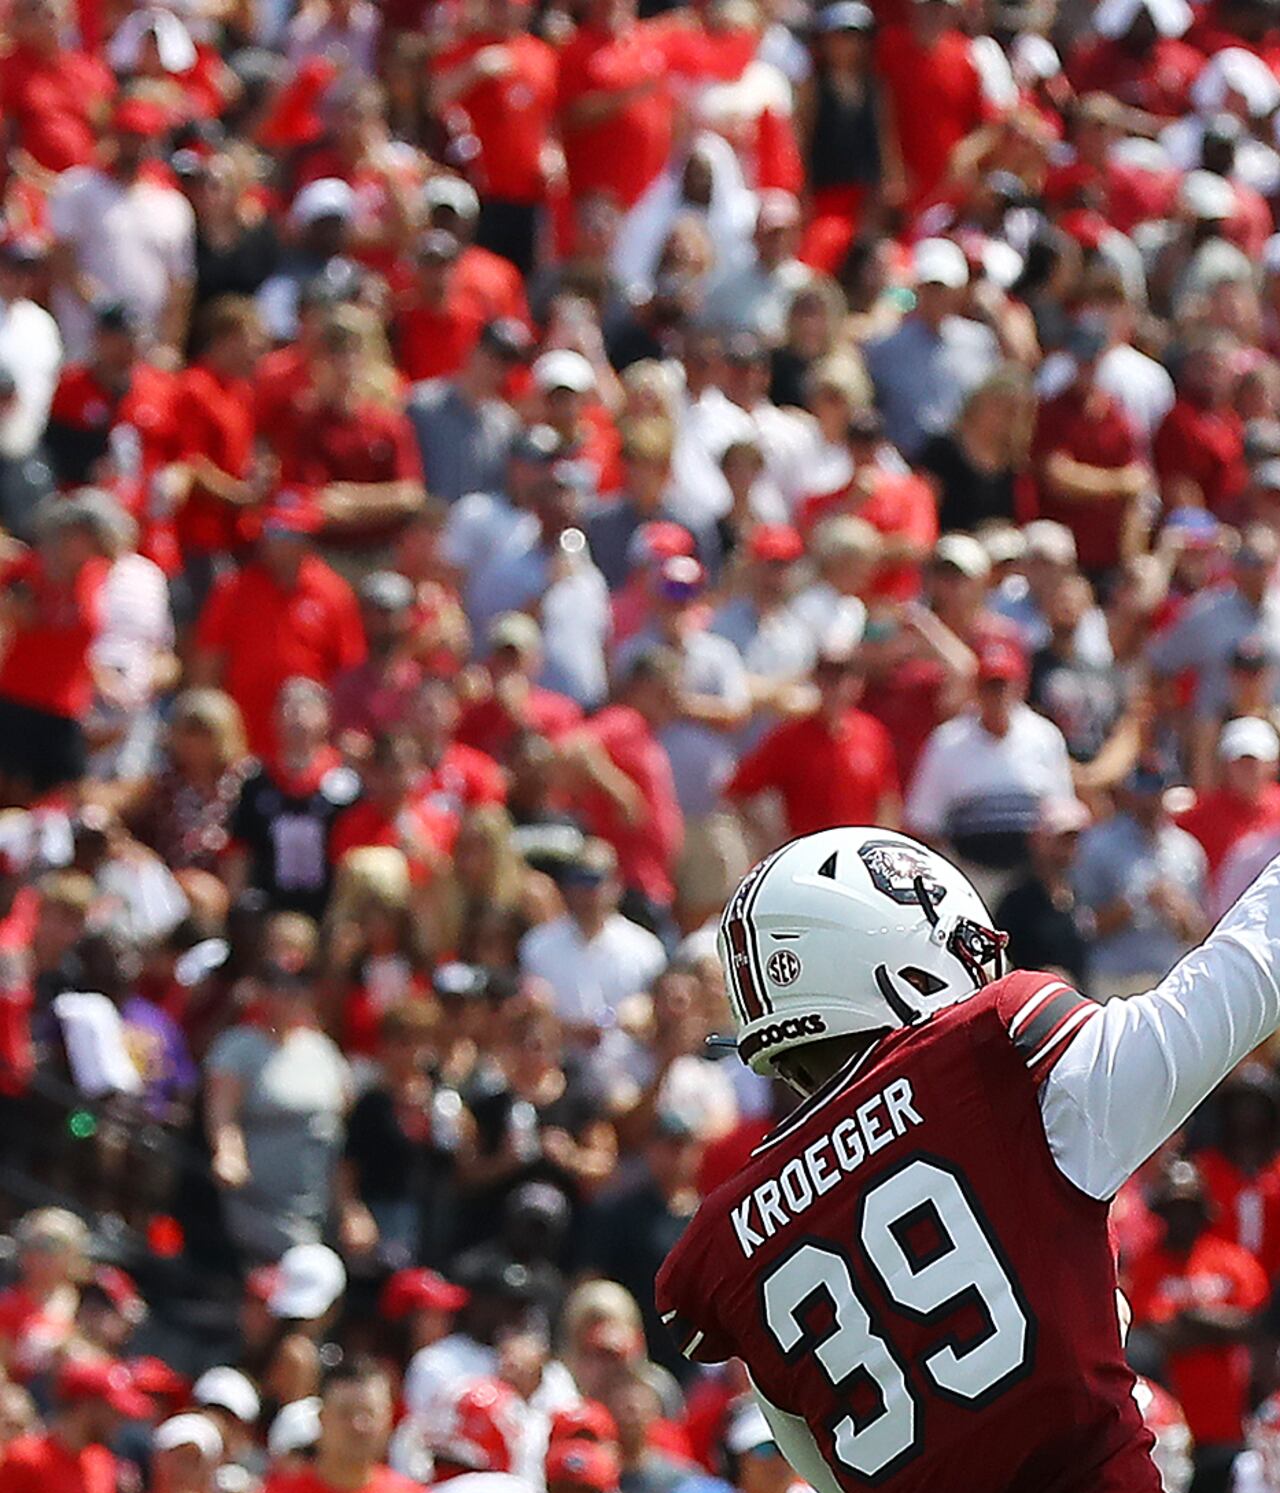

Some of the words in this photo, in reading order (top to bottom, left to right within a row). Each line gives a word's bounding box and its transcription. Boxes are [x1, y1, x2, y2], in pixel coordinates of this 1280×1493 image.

[768, 951, 800, 985] SEC
[728, 1077, 925, 1259] KROEGER
[761, 1157, 1030, 1479] 39
